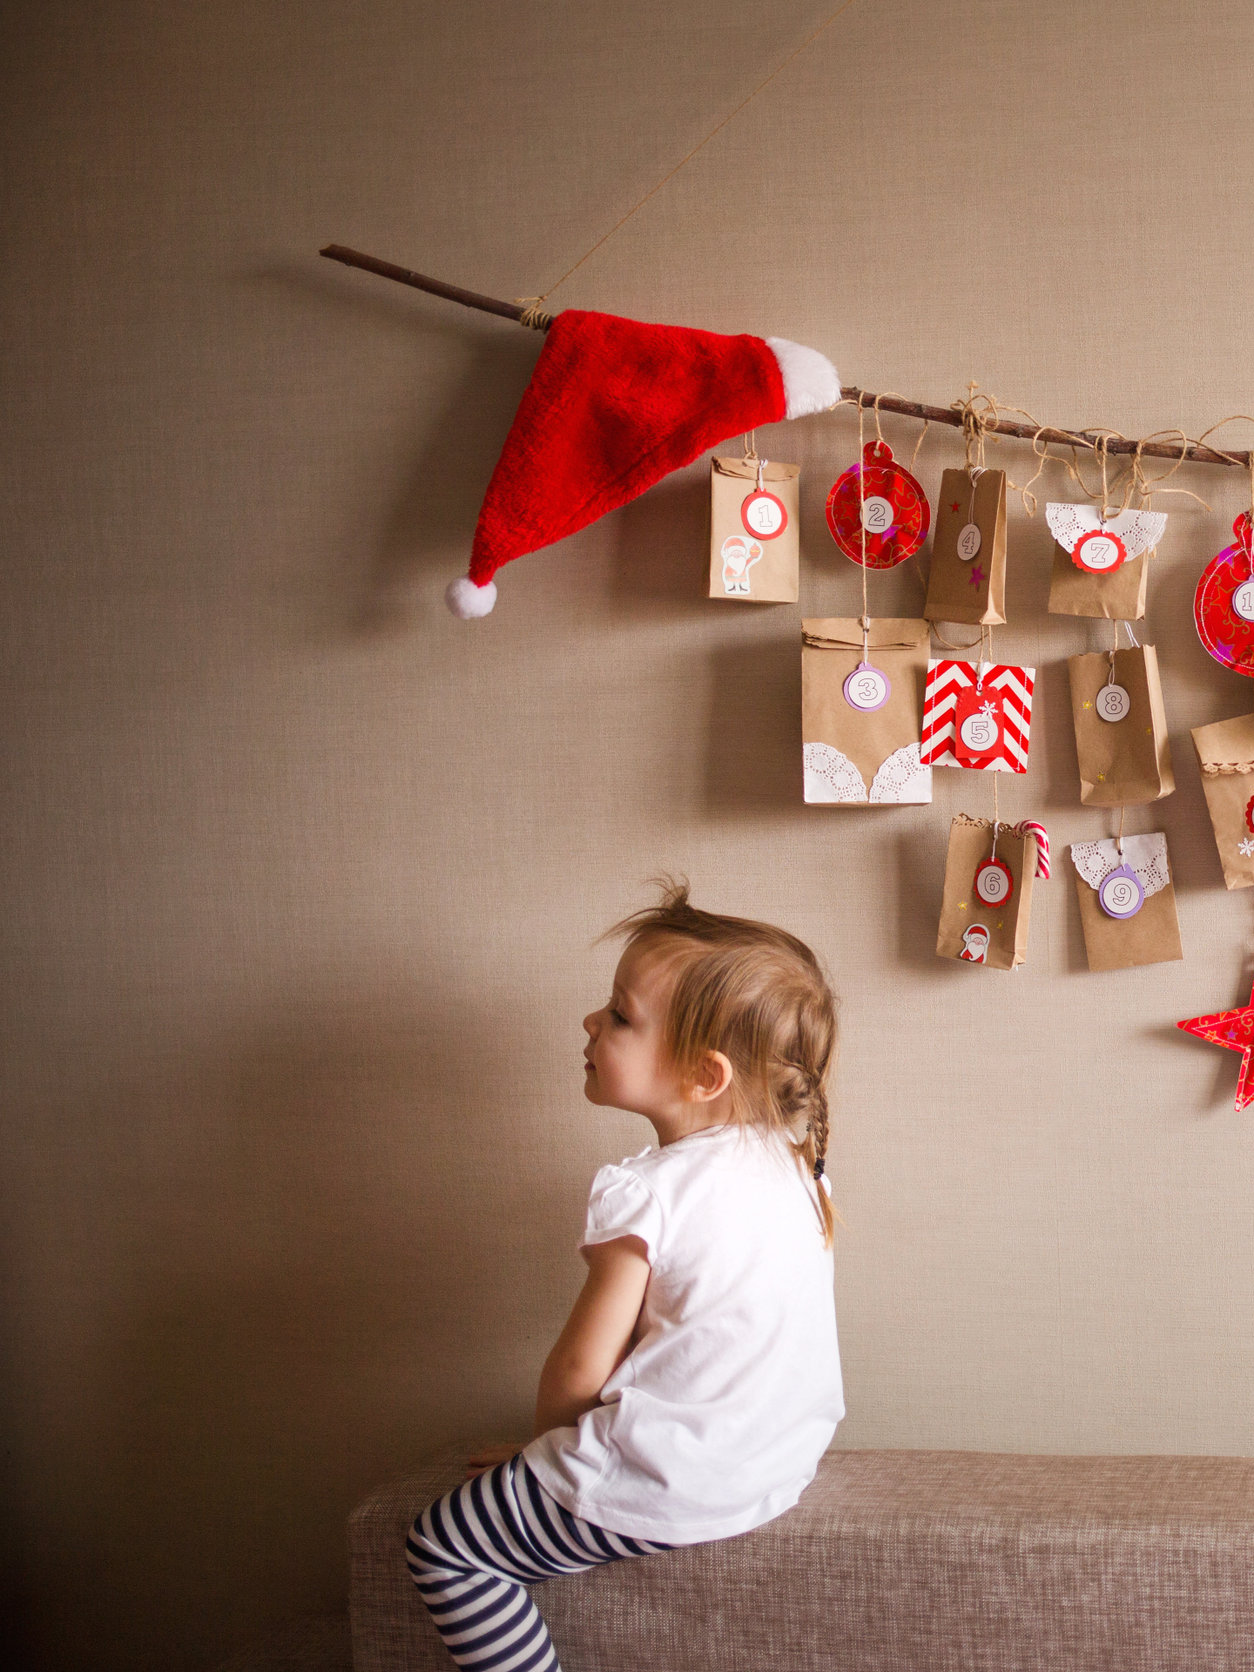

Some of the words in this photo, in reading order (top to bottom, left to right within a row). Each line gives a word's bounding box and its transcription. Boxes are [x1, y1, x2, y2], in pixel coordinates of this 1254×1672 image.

[758, 505, 773, 528] 1
[868, 504, 886, 527] 2
[961, 532, 976, 555] 4
[1090, 544, 1111, 564] 7
[857, 678, 879, 701] 3
[1104, 692, 1124, 715] 8
[970, 721, 991, 743] 5
[984, 872, 1001, 895] 6
[1112, 883, 1132, 906] 9
